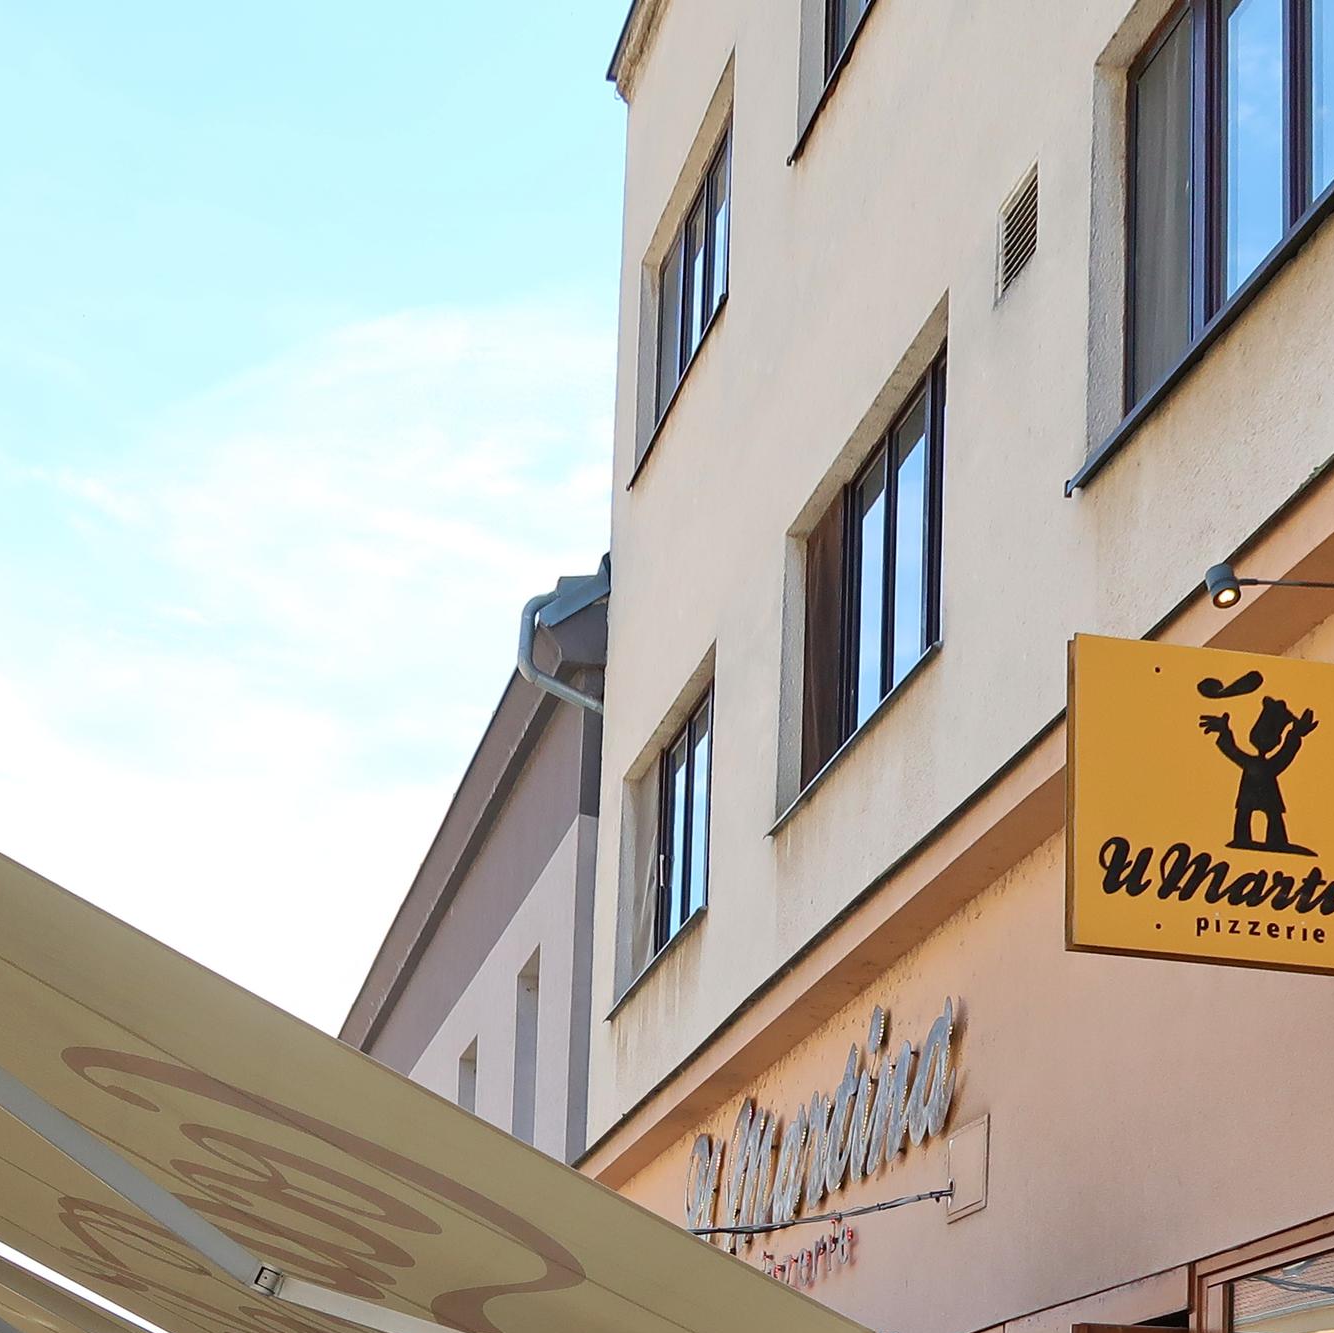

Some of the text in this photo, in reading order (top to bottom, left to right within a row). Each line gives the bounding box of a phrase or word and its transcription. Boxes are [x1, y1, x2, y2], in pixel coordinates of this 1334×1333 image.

[1098, 836, 1154, 898] U
[1195, 914, 1327, 945] pizzerie
[722, 996, 961, 1254] Martina
